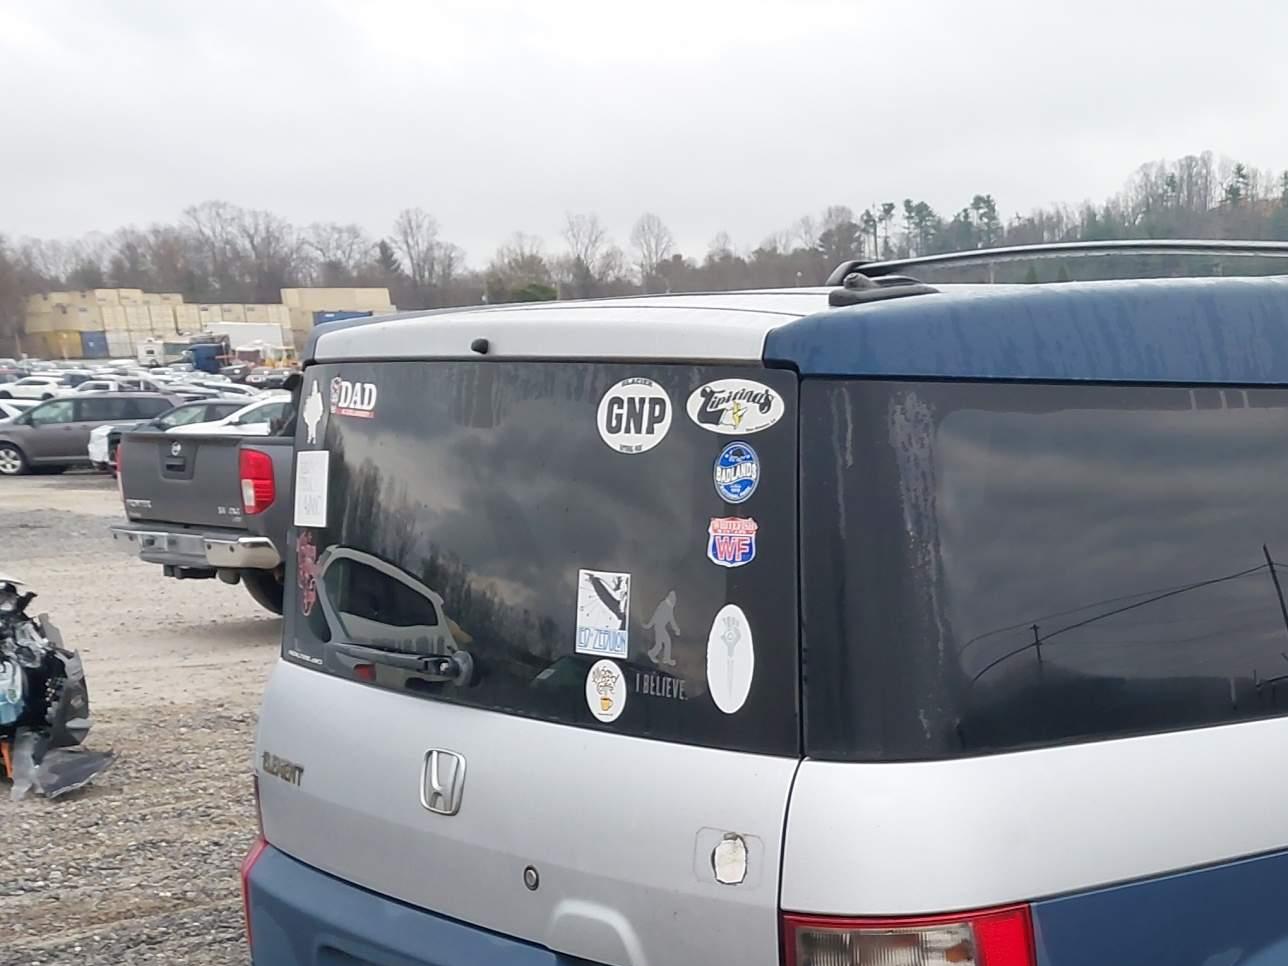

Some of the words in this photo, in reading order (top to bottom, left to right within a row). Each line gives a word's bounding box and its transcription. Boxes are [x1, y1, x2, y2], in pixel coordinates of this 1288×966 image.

[338, 380, 377, 410] DAD
[605, 396, 667, 435] GNP
[716, 462, 757, 483] BADLANDS
[714, 535, 751, 562] WF
[635, 673, 640, 693] I
